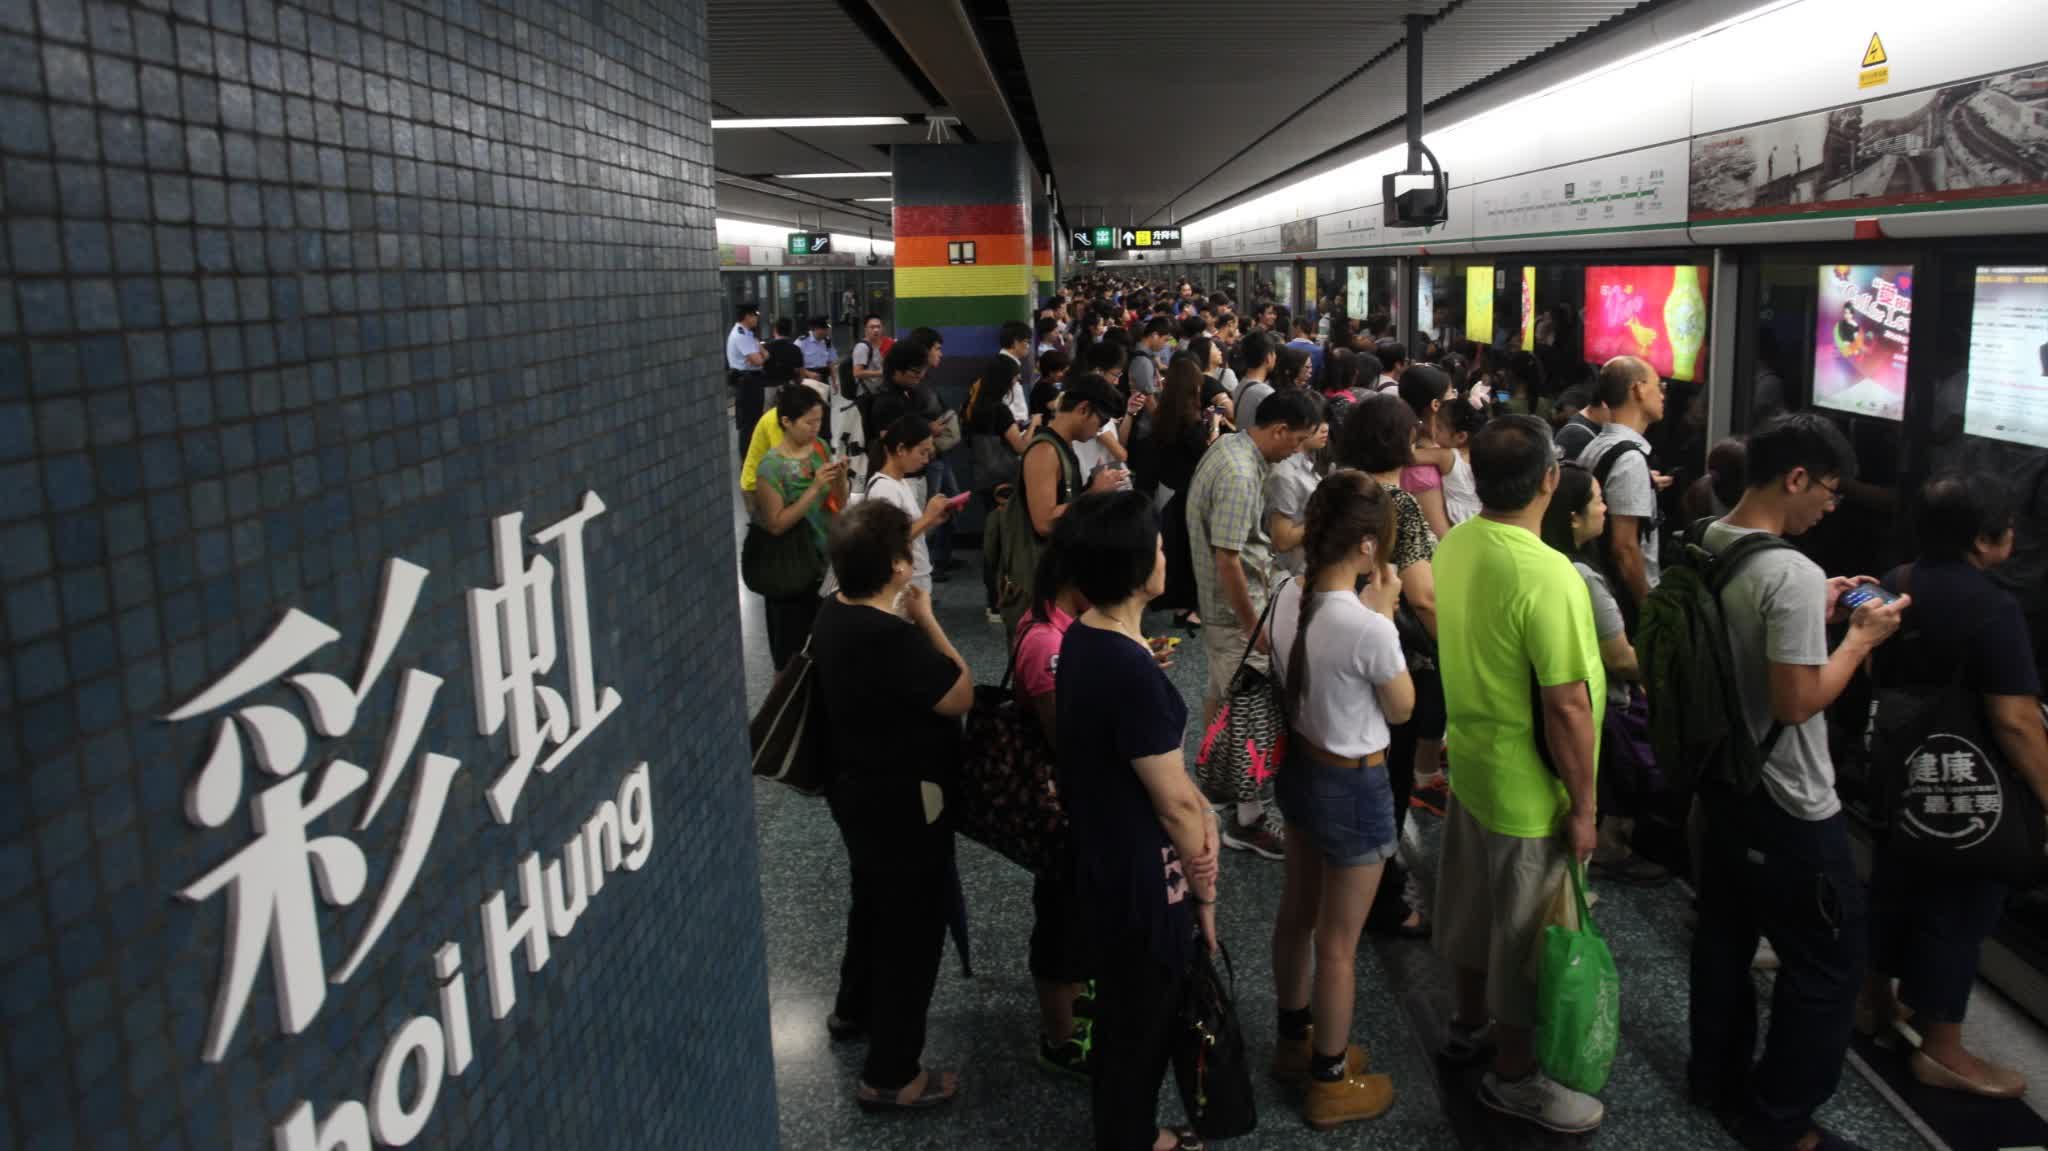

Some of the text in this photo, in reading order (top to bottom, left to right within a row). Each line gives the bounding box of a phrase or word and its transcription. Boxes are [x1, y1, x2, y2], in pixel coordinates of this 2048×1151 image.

[161, 489, 622, 1063] 彩虹
[1909, 751, 1978, 786] 健康
[1923, 794, 2001, 814] 最重要
[481, 760, 654, 1020] Hung
